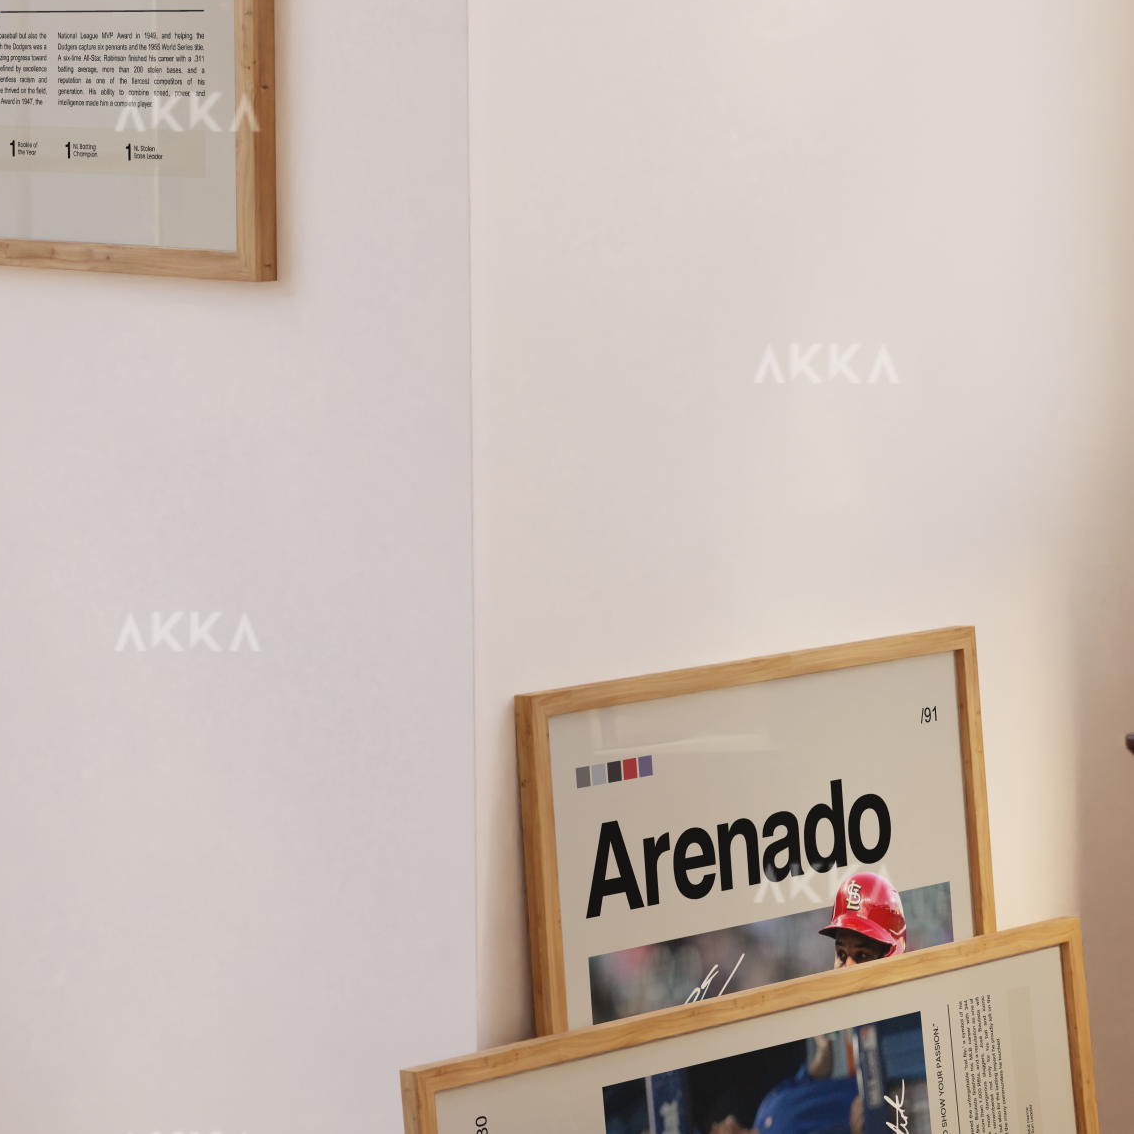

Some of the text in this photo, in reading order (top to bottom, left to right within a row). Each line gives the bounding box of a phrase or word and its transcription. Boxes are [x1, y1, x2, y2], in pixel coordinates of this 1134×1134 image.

[10, 139, 16, 157] 1
[65, 141, 71, 159] 1
[126, 143, 132, 161] 1
[919, 706, 938, 726] /91
[585, 779, 892, 919] Arenado
[936, 1070, 945, 1096] YOUR
[939, 1098, 948, 1128] SHOW
